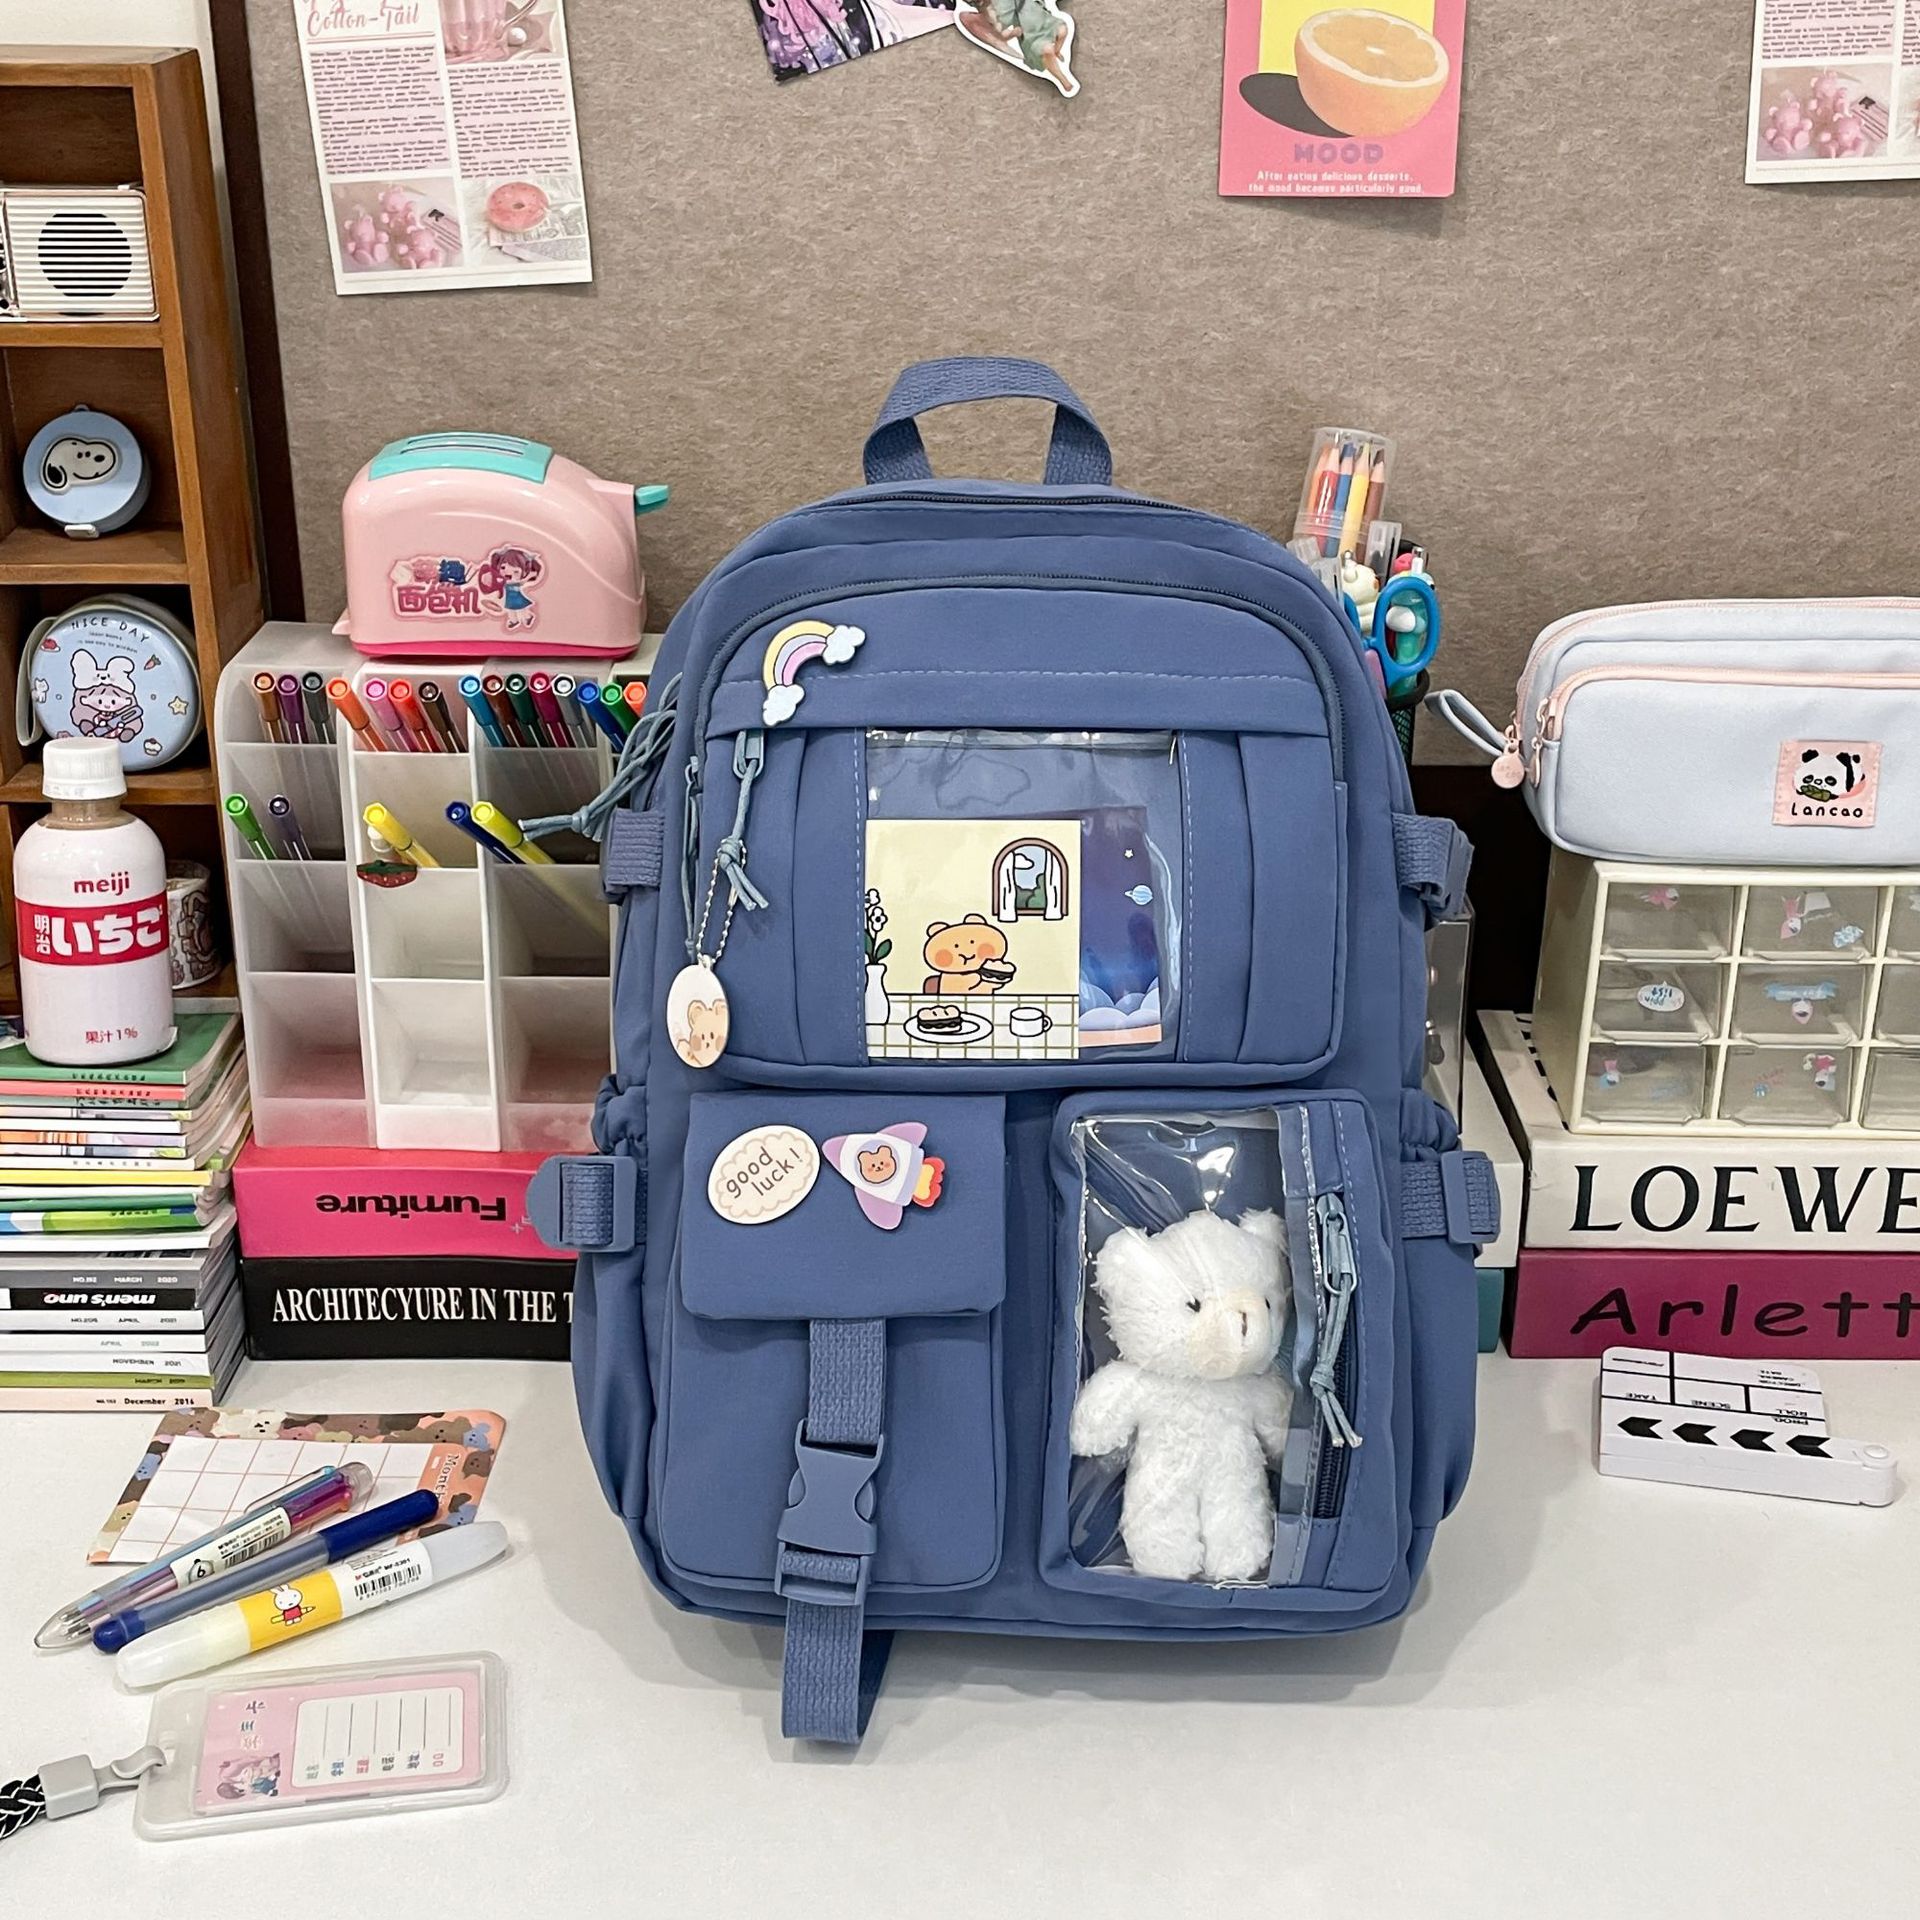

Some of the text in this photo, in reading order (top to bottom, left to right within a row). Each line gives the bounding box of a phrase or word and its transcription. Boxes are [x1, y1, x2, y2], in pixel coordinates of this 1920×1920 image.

[306, 2, 419, 37] Cotton-Tail
[1294, 142, 1384, 164] MOOD
[71, 617, 109, 630] NICE
[119, 621, 150, 642] DAY
[74, 871, 130, 896] meiji
[34, 914, 51, 955] 明治
[725, 1145, 774, 1199] good
[315, 1194, 507, 1221] Furniture
[1569, 1165, 1920, 1233] LOEWE
[43, 1293, 156, 1307] men's uno
[272, 1286, 465, 1323] ARCHITECYURE
[470, 1287, 497, 1321] IN
[503, 1289, 557, 1323] THE
[124, 1397, 166, 1405] December
